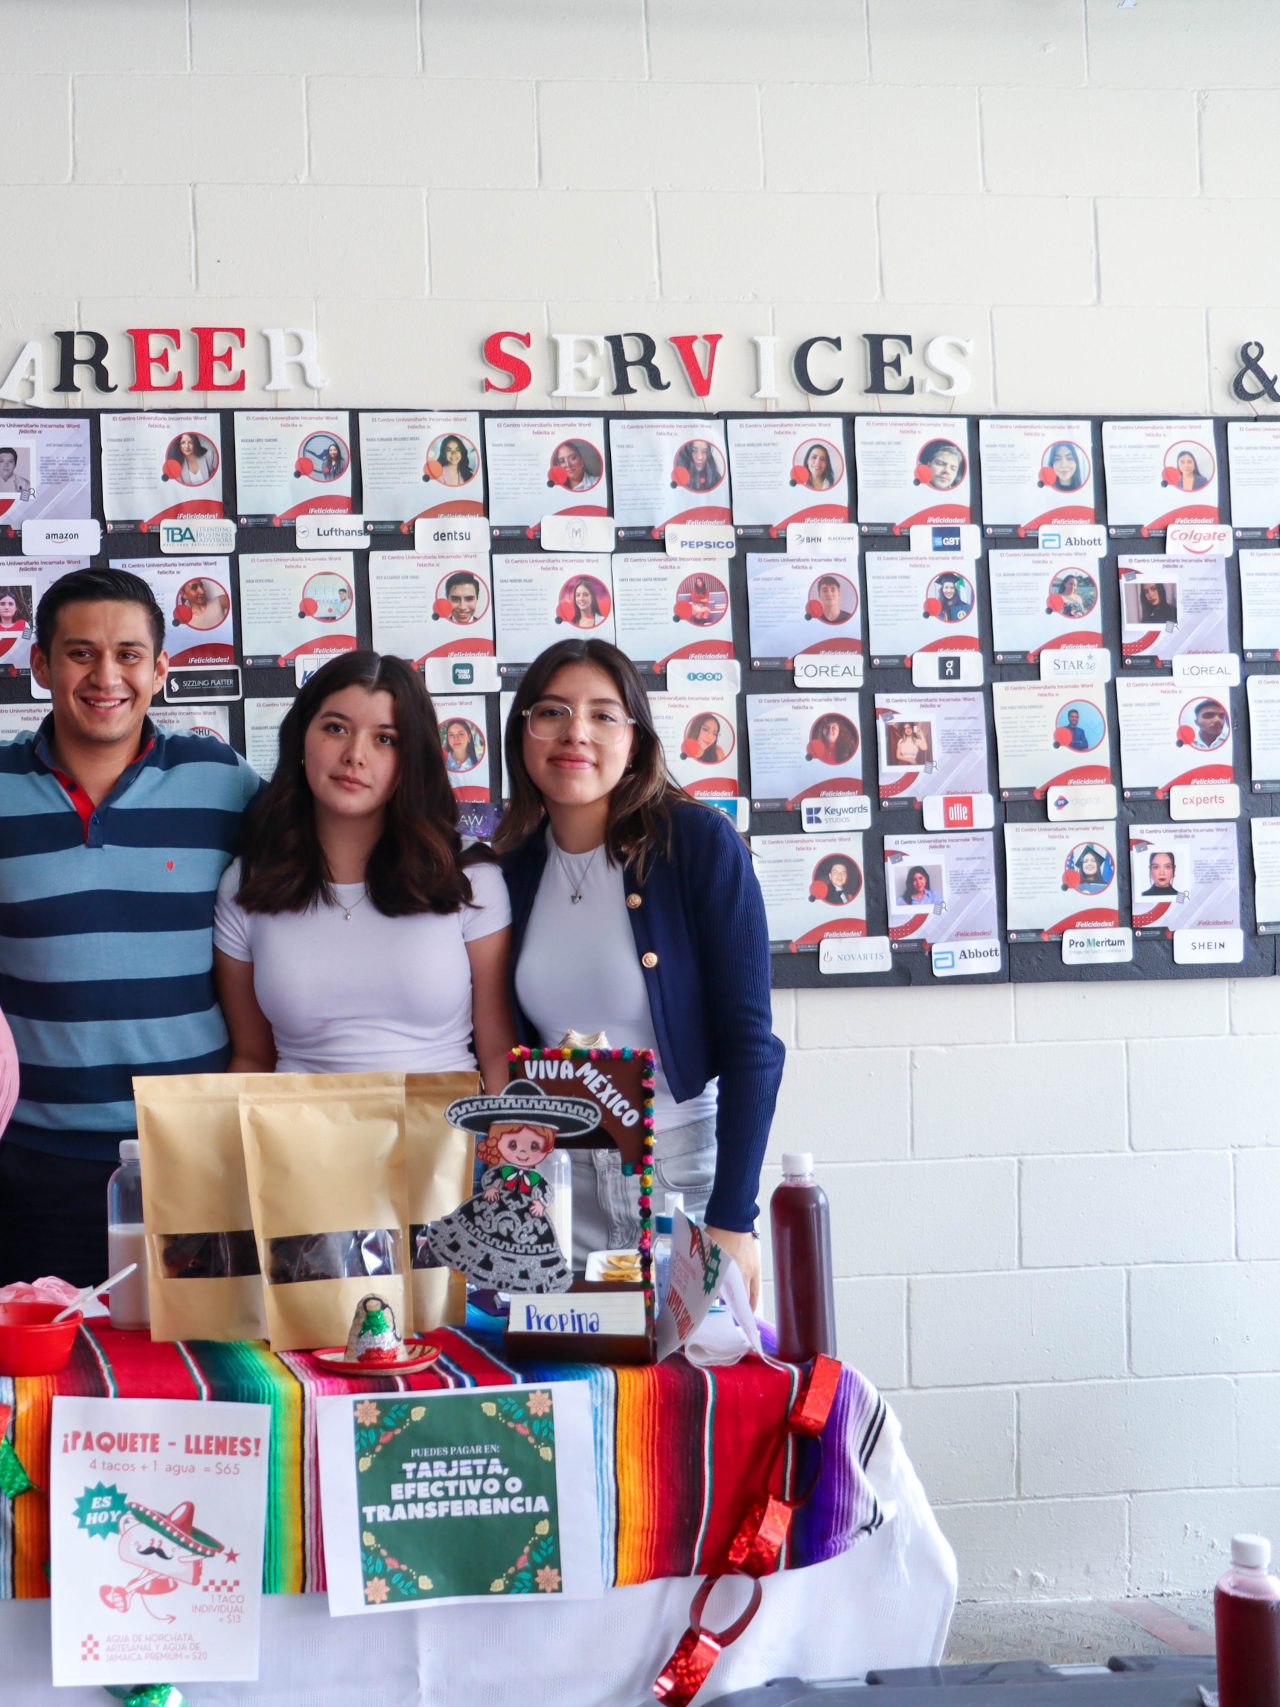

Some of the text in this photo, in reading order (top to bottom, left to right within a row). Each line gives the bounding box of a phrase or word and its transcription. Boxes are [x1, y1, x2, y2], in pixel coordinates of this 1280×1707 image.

[483, 331, 974, 399] SERVICES
[1231, 341, 1280, 402] &
[45, 532, 79, 540] amazon
[162, 526, 196, 543] TBA
[317, 527, 368, 536] Lufthans
[433, 531, 471, 541] dentsu
[1170, 529, 1227, 544] Colgate
[680, 540, 735, 549] PEPSICO
[1065, 537, 1103, 546] Abbott
[824, 804, 868, 816] Keywords
[948, 803, 968, 820] ollie
[1069, 939, 1085, 949] Pro
[1191, 941, 1225, 950] SHEIN
[837, 952, 884, 961] NOVARTIS
[958, 947, 1000, 960] Abbott
[524, 1059, 640, 1127] VIVA MÉXICO
[525, 1304, 600, 1334] Propina
[62, 1430, 160, 1454] ¡PAQUETE
[184, 1434, 261, 1457] LLENES!
[410, 1444, 500, 1458] PUEDES PAGAR EN:
[89, 1460, 98, 1470] 4
[102, 1460, 136, 1472] tacos
[165, 1464, 196, 1476] agua
[215, 1462, 240, 1476] $65
[401, 1457, 509, 1479] TARJETA,
[390, 1476, 523, 1500] EFECTIVO O
[91, 1496, 112, 1510] ES
[362, 1495, 550, 1523] TRANSFERENCIA
[85, 1510, 121, 1526] HOY
[218, 1594, 245, 1604] TACO
[192, 1605, 245, 1614] INDIVIDUAL
[145, 1634, 193, 1643] HORCHATA
[106, 1652, 142, 1662] JAMAICA
[144, 1651, 183, 1661] PREMIUM
